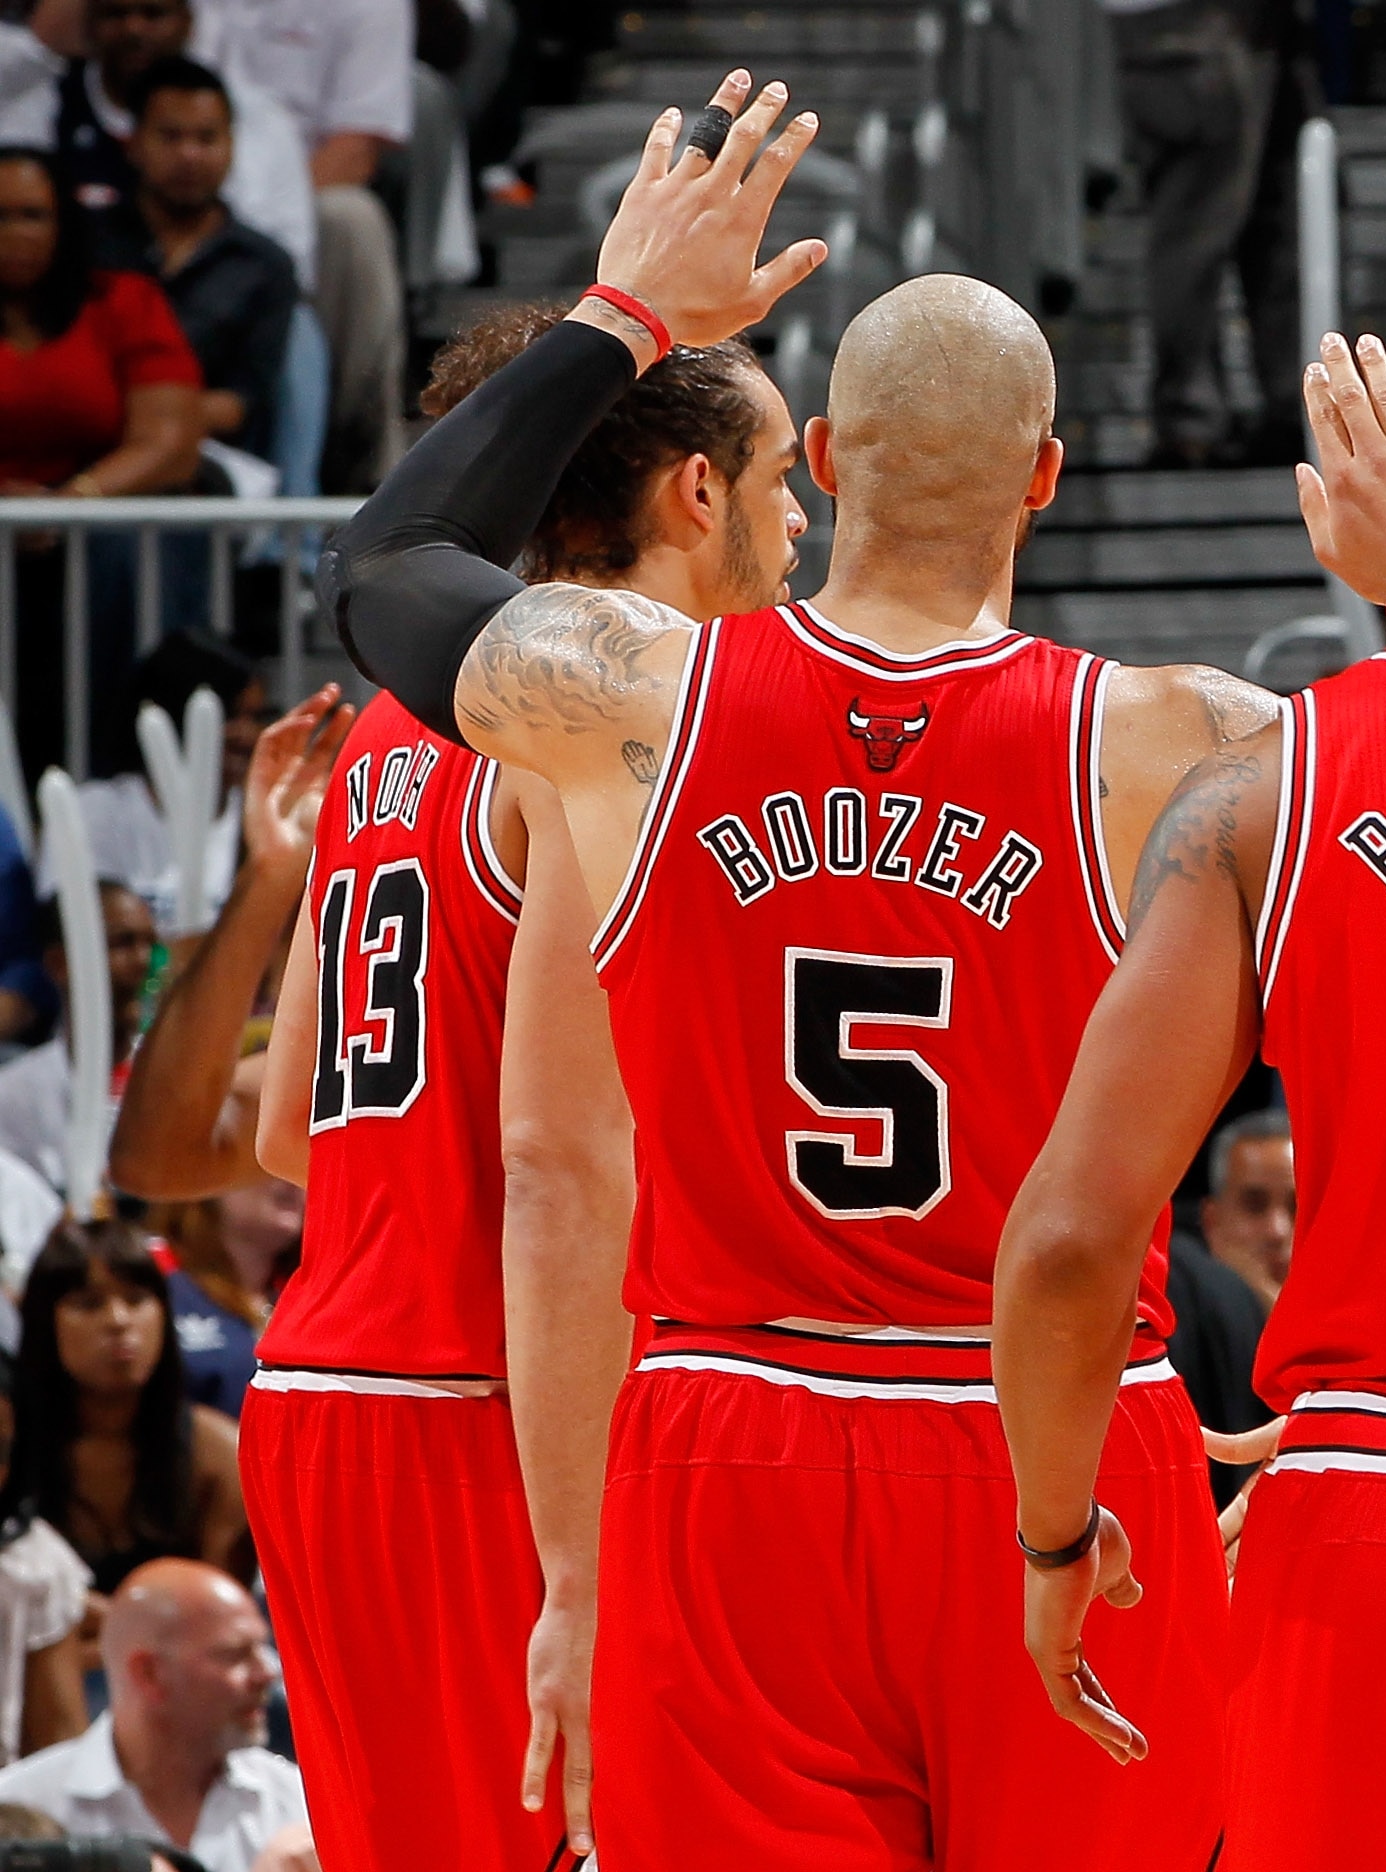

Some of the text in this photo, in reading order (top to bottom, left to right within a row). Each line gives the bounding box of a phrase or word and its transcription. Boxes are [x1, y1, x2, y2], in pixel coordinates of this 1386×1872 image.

[346, 739, 440, 844] NOH
[695, 787, 1043, 931] BOOZER
[308, 857, 429, 1137] 13
[784, 946, 954, 1221] 5
